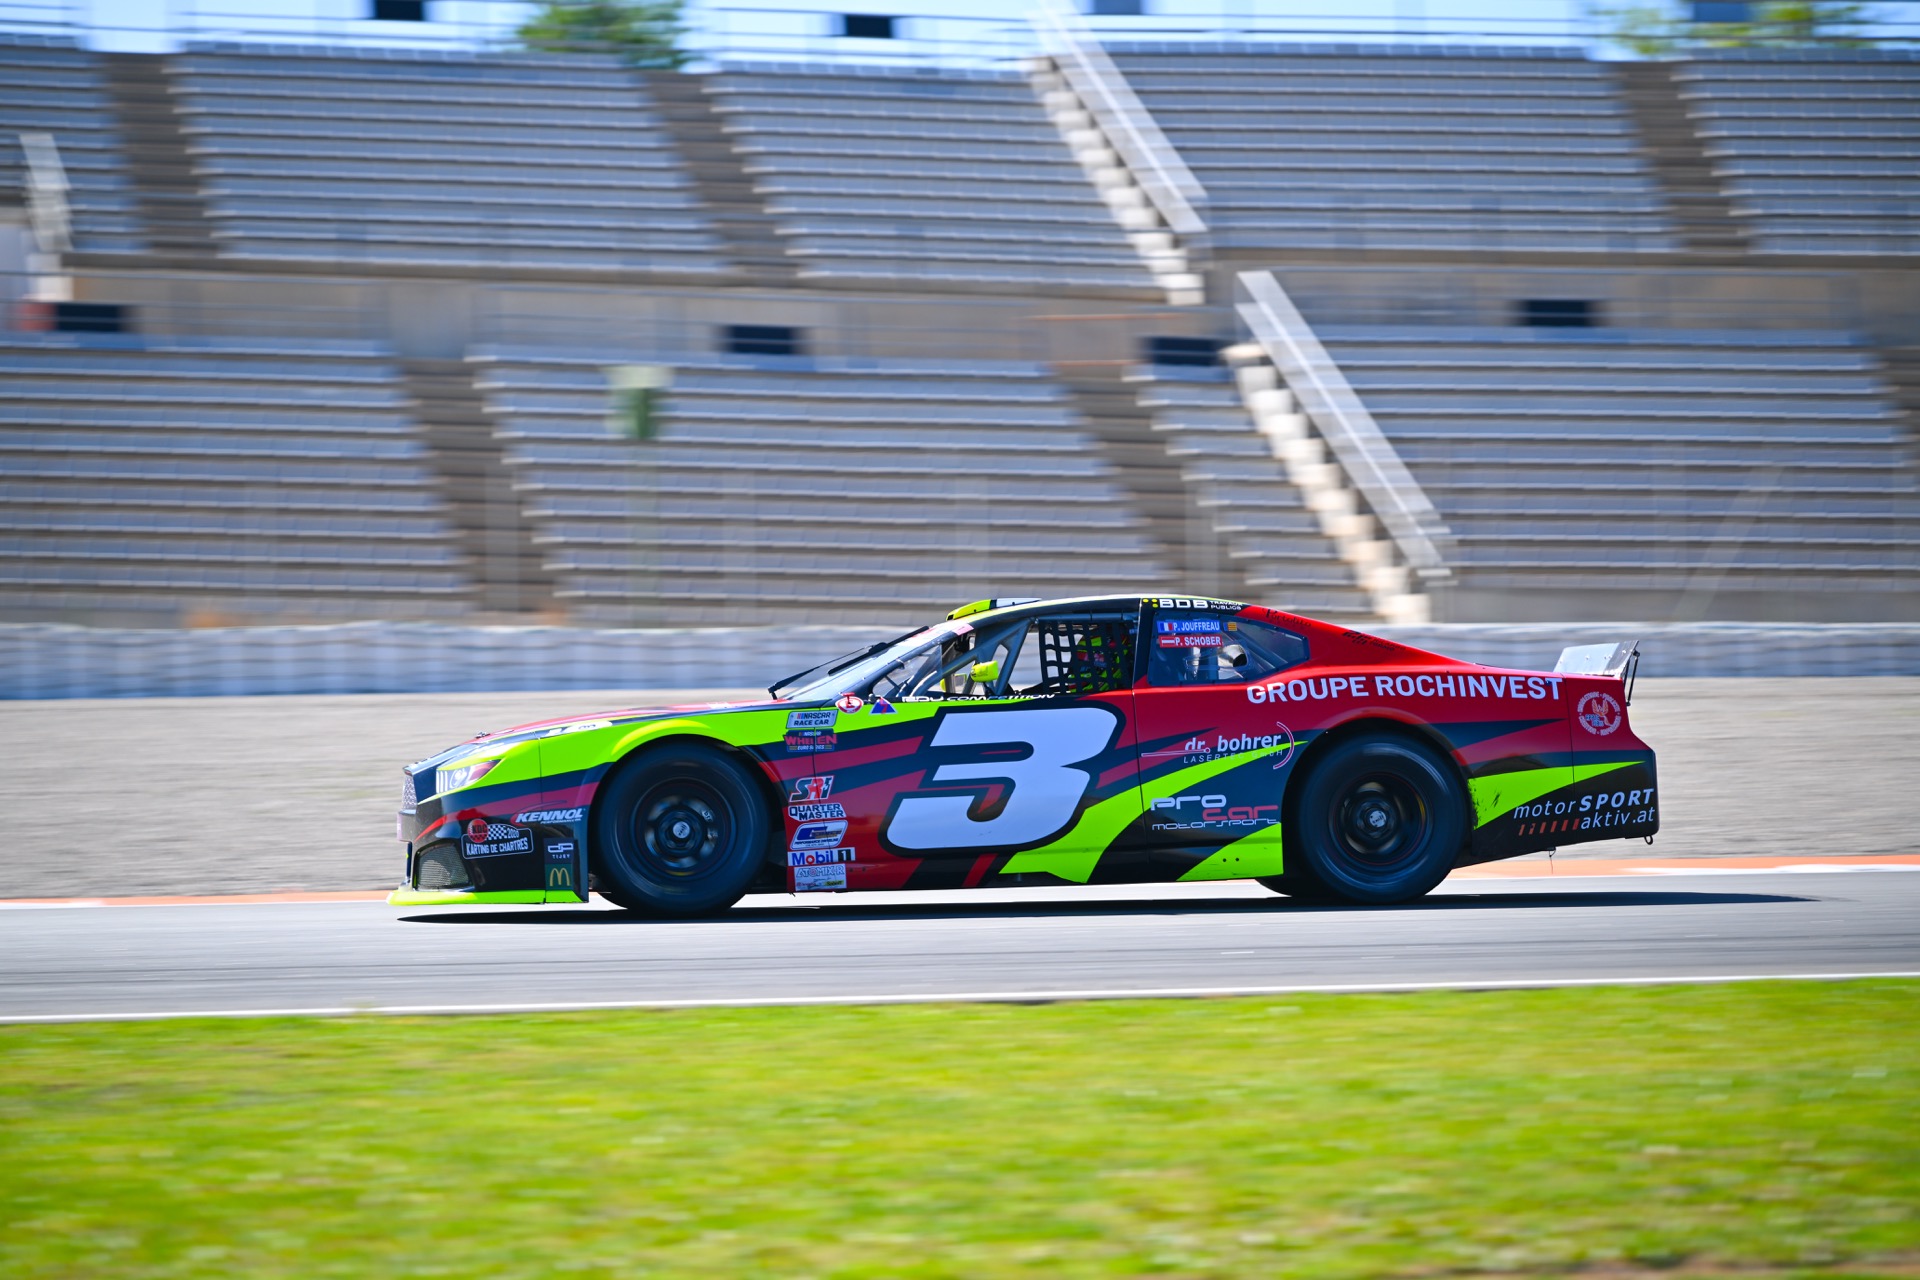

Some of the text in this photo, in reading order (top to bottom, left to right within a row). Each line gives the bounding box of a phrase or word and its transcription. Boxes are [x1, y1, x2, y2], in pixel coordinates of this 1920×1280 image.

[1159, 598, 1209, 609] BDB
[1181, 622, 1220, 631] JOUFFREAU
[1174, 636, 1222, 646] P. SCHOBER
[1247, 675, 1563, 704] GROUPE ROCHINVEST
[804, 711, 831, 719] NASCAR
[1217, 733, 1282, 752] bohrer
[1183, 752, 1245, 764] LASERTEC
[886, 707, 1118, 850] 3
[515, 808, 584, 823] KENNOL
[789, 803, 841, 817] QUARTER
[798, 810, 845, 821] MASTER
[1151, 818, 1283, 831] motorsport
[1580, 807, 1656, 830] aktiv.at
[507, 828, 519, 839] 2020
[466, 837, 529, 855] KARTING DE CHARTRES
[791, 850, 834, 866] Mobil
